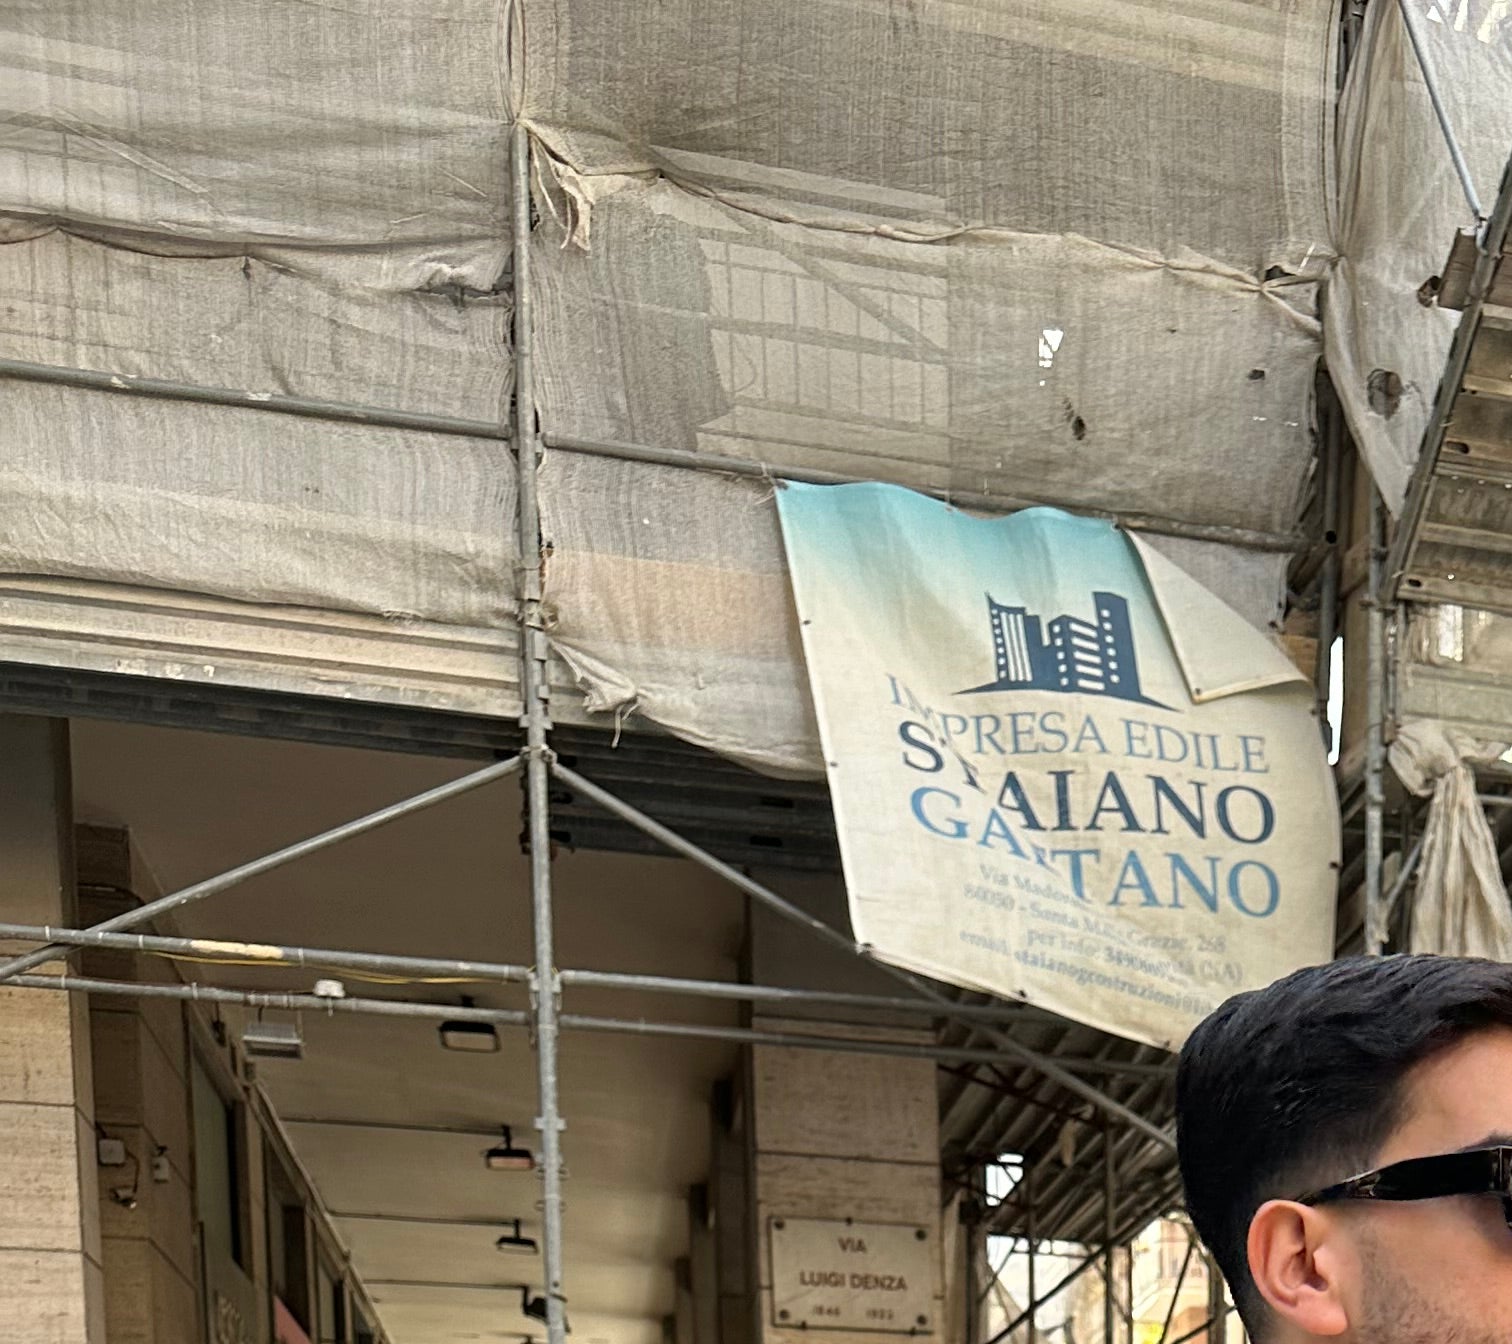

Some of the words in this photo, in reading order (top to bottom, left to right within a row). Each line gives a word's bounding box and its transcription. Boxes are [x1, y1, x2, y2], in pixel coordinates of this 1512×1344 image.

[885, 672, 1108, 757] IPRESA
[1124, 728, 1271, 775] EDILE
[838, 1237, 867, 1254] VIA
[799, 1270, 846, 1288] LUIGI
[849, 1272, 908, 1292] DENZA
